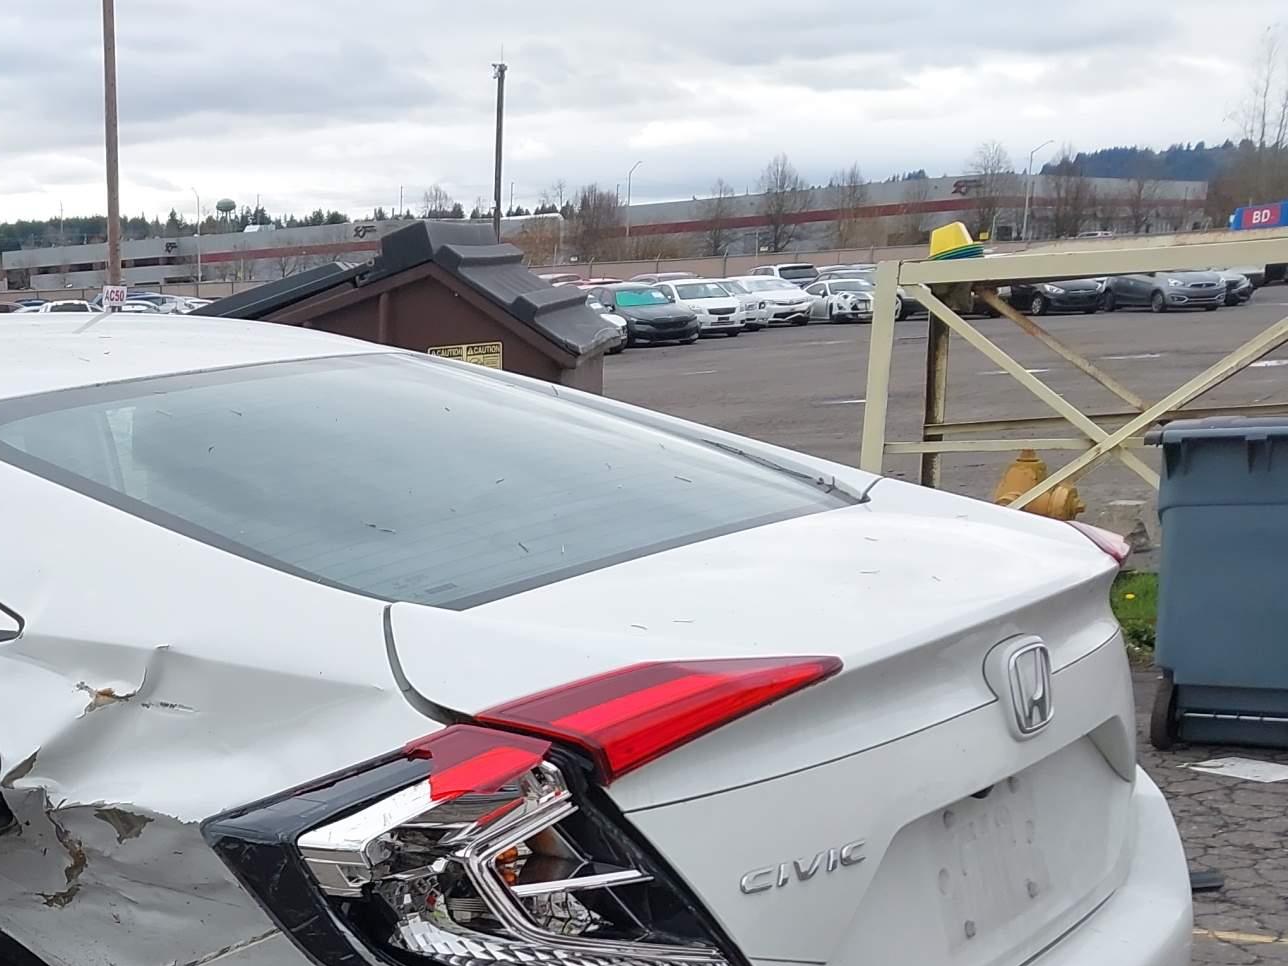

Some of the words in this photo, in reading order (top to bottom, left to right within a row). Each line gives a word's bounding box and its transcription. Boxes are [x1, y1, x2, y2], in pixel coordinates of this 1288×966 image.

[1252, 209, 1271, 224] BD
[473, 345, 500, 355] CAUTION
[739, 838, 867, 895] CIVIC
